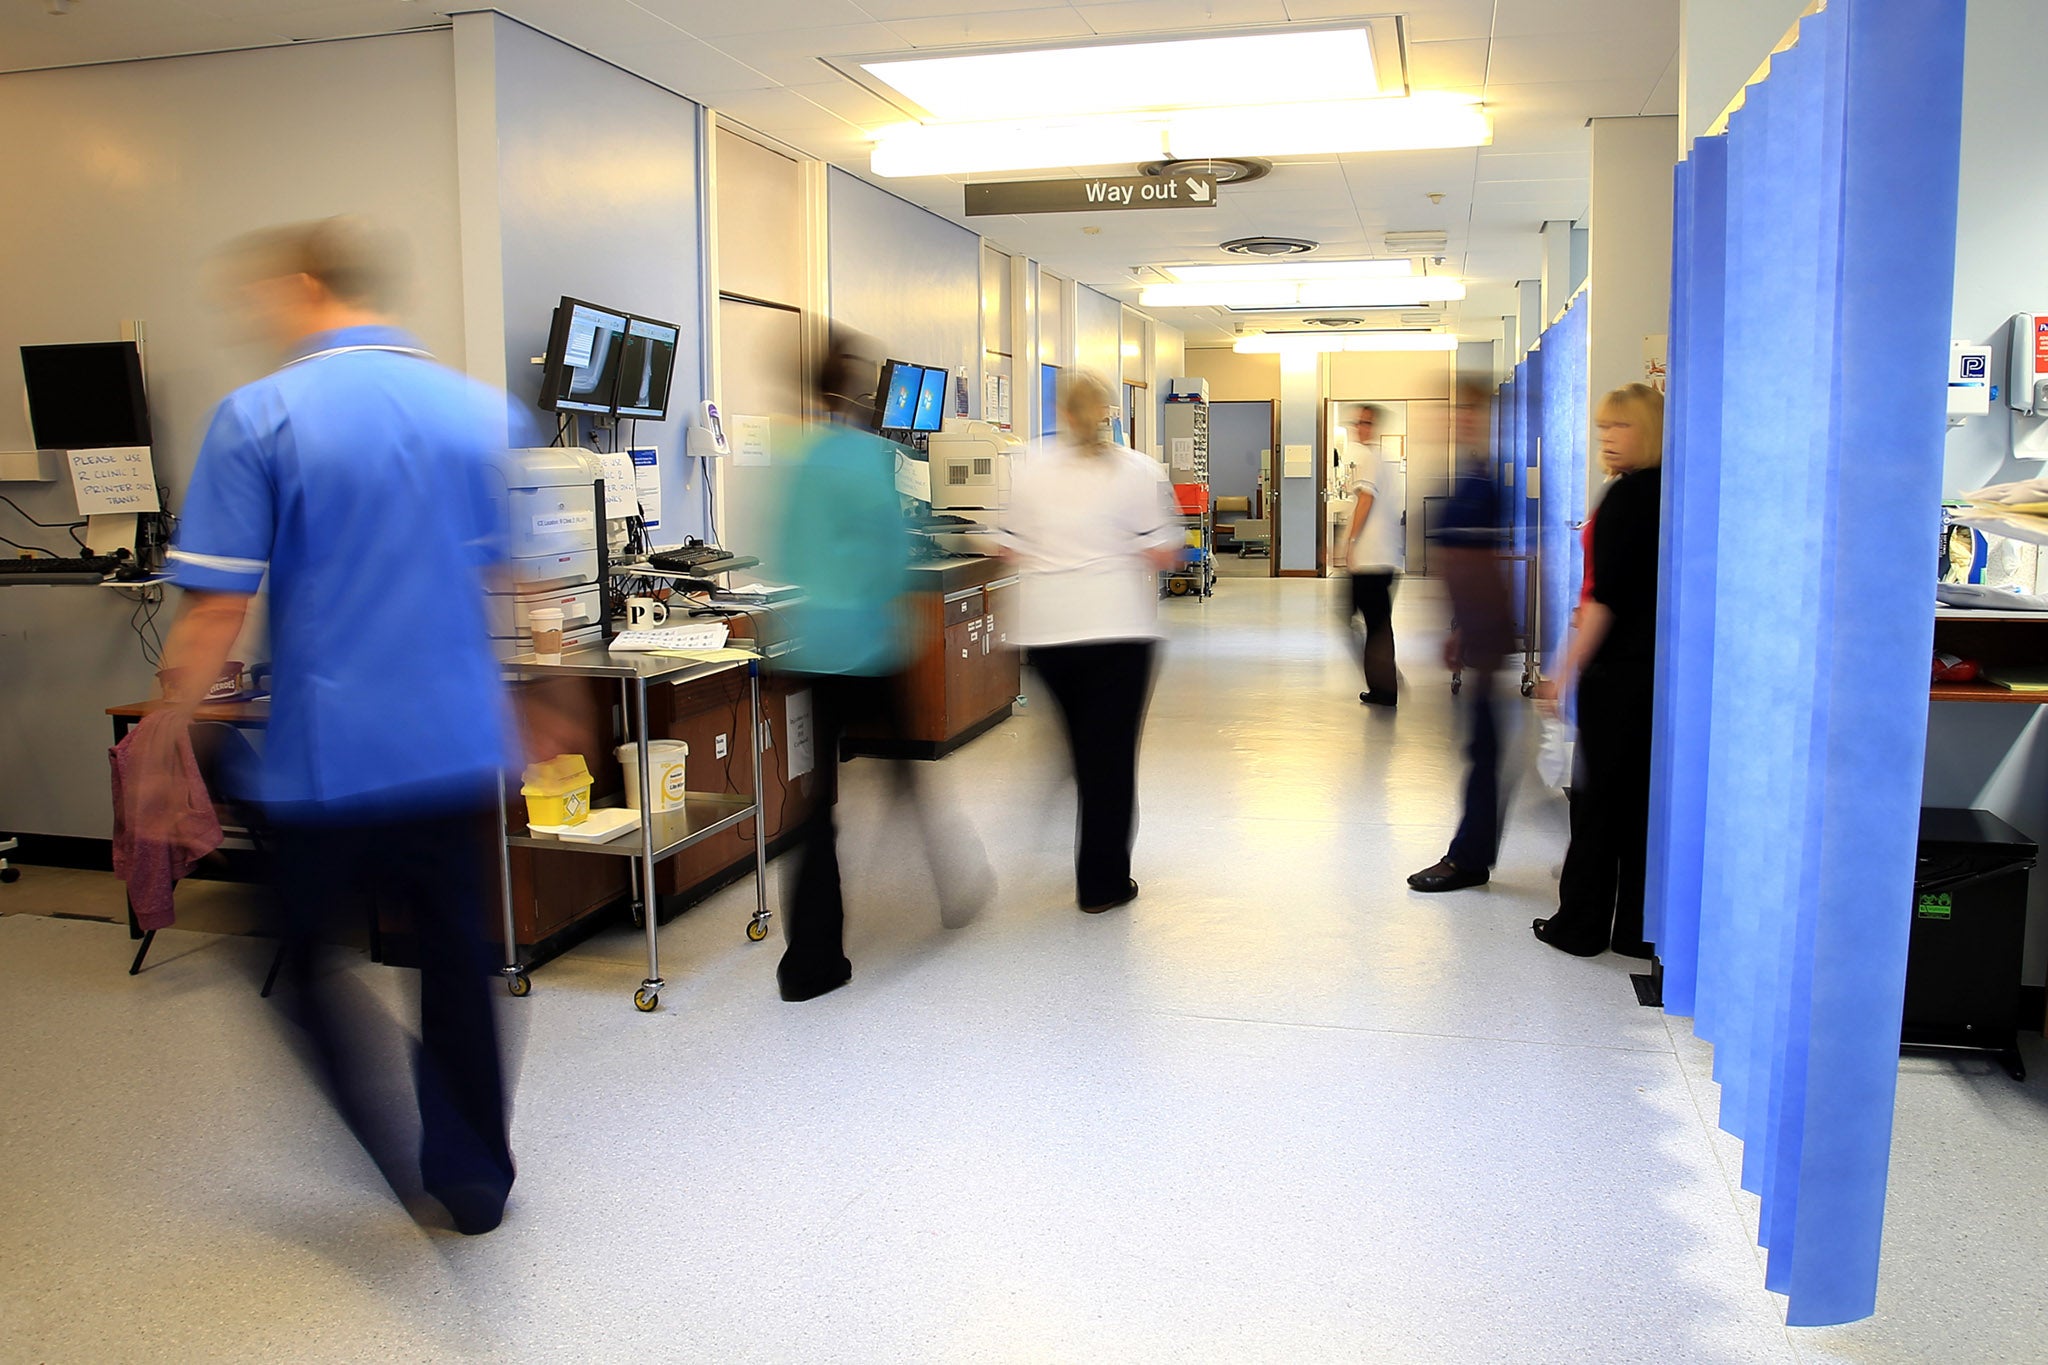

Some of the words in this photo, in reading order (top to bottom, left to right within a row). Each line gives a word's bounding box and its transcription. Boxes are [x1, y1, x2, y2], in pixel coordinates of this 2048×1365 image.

[1085, 182, 1134, 205] Way
[1140, 179, 1178, 200] out
[73, 455, 117, 466] PLEASE
[124, 454, 142, 463] USE
[83, 483, 133, 495] PRINTER
[105, 495, 140, 504] THANKS
[631, 606, 645, 624] P
